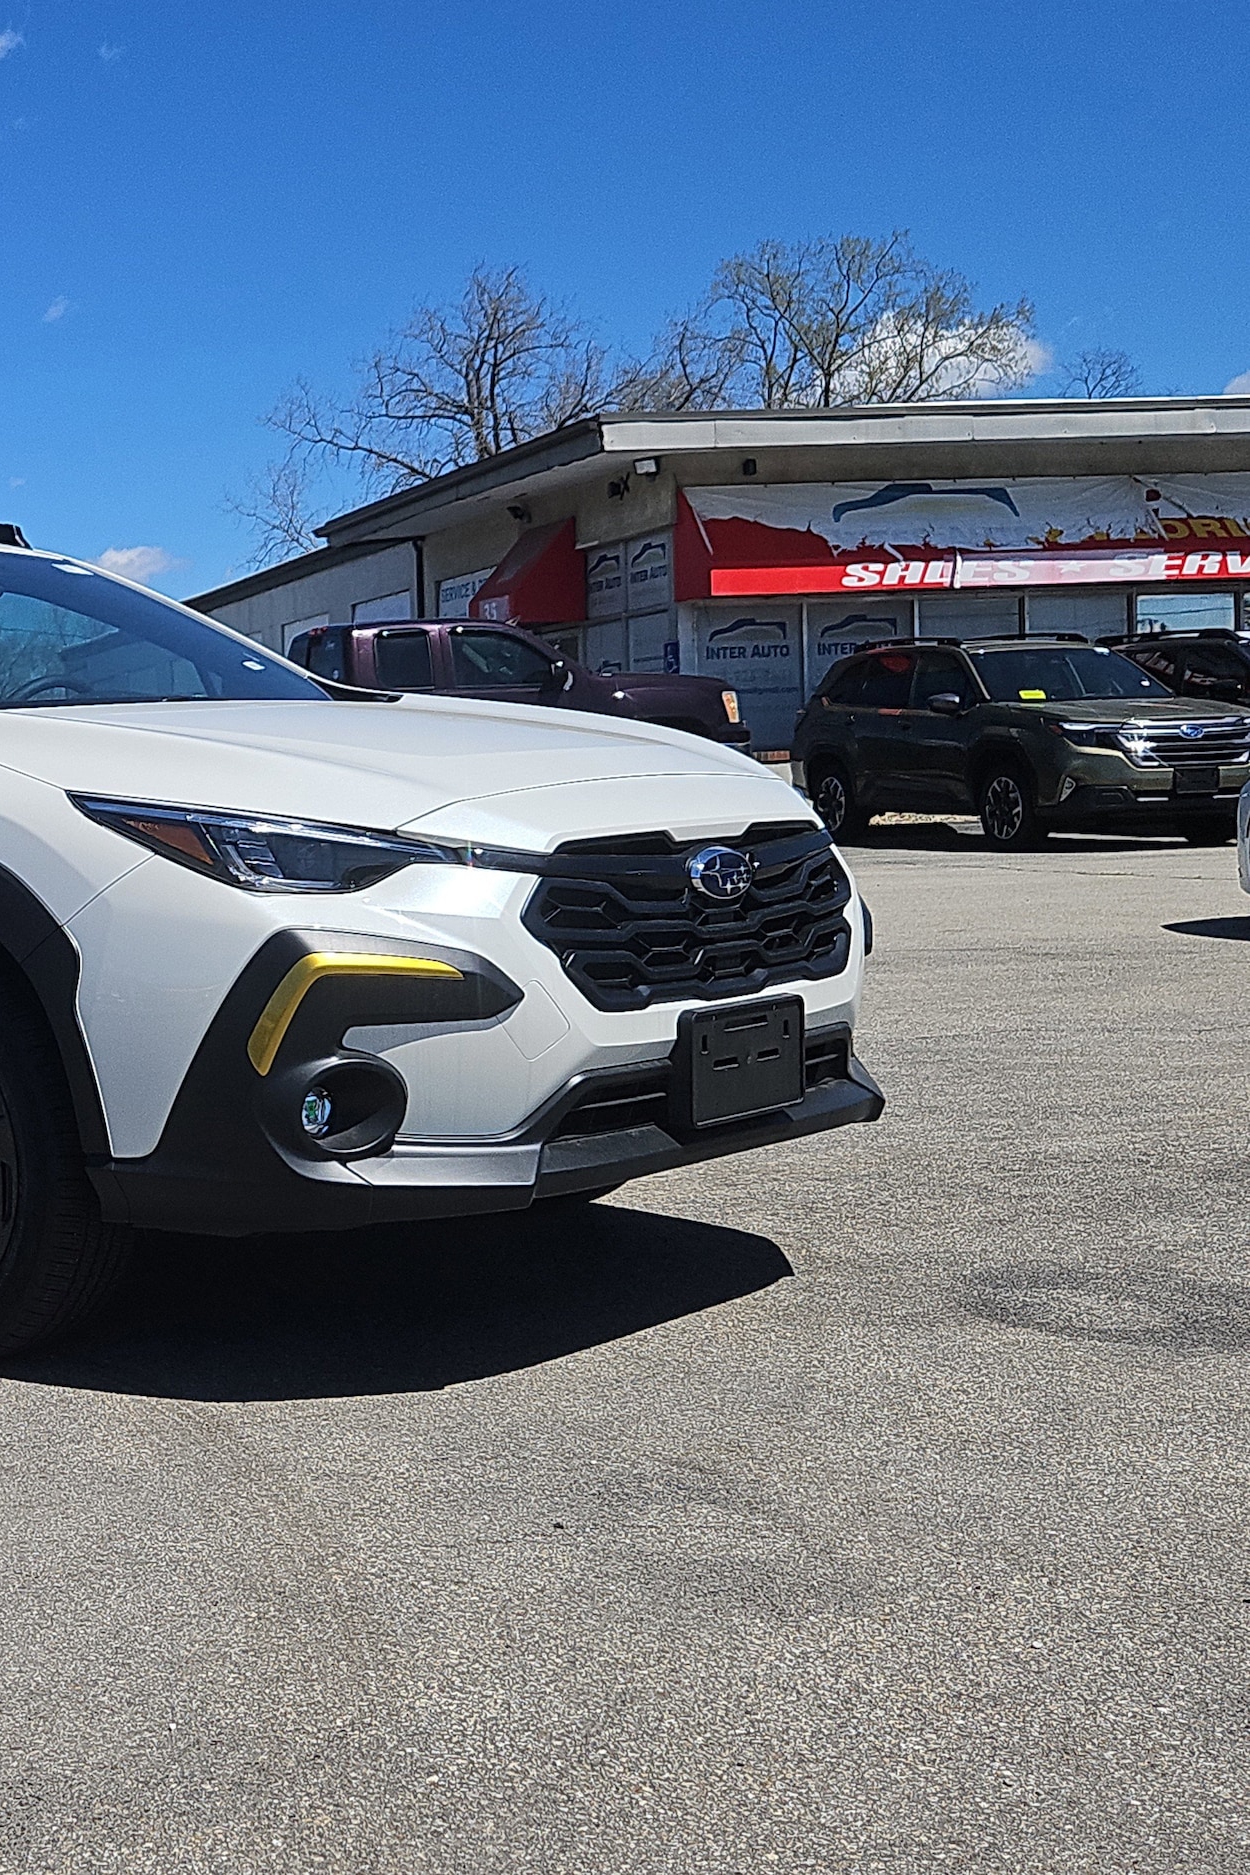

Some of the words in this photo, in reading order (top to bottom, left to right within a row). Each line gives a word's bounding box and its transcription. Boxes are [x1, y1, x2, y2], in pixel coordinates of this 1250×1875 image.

[841, 560, 1034, 587] SALES
[1108, 551, 1250, 577] SERV
[705, 645, 746, 660] INTER
[751, 643, 790, 658] AUTO
